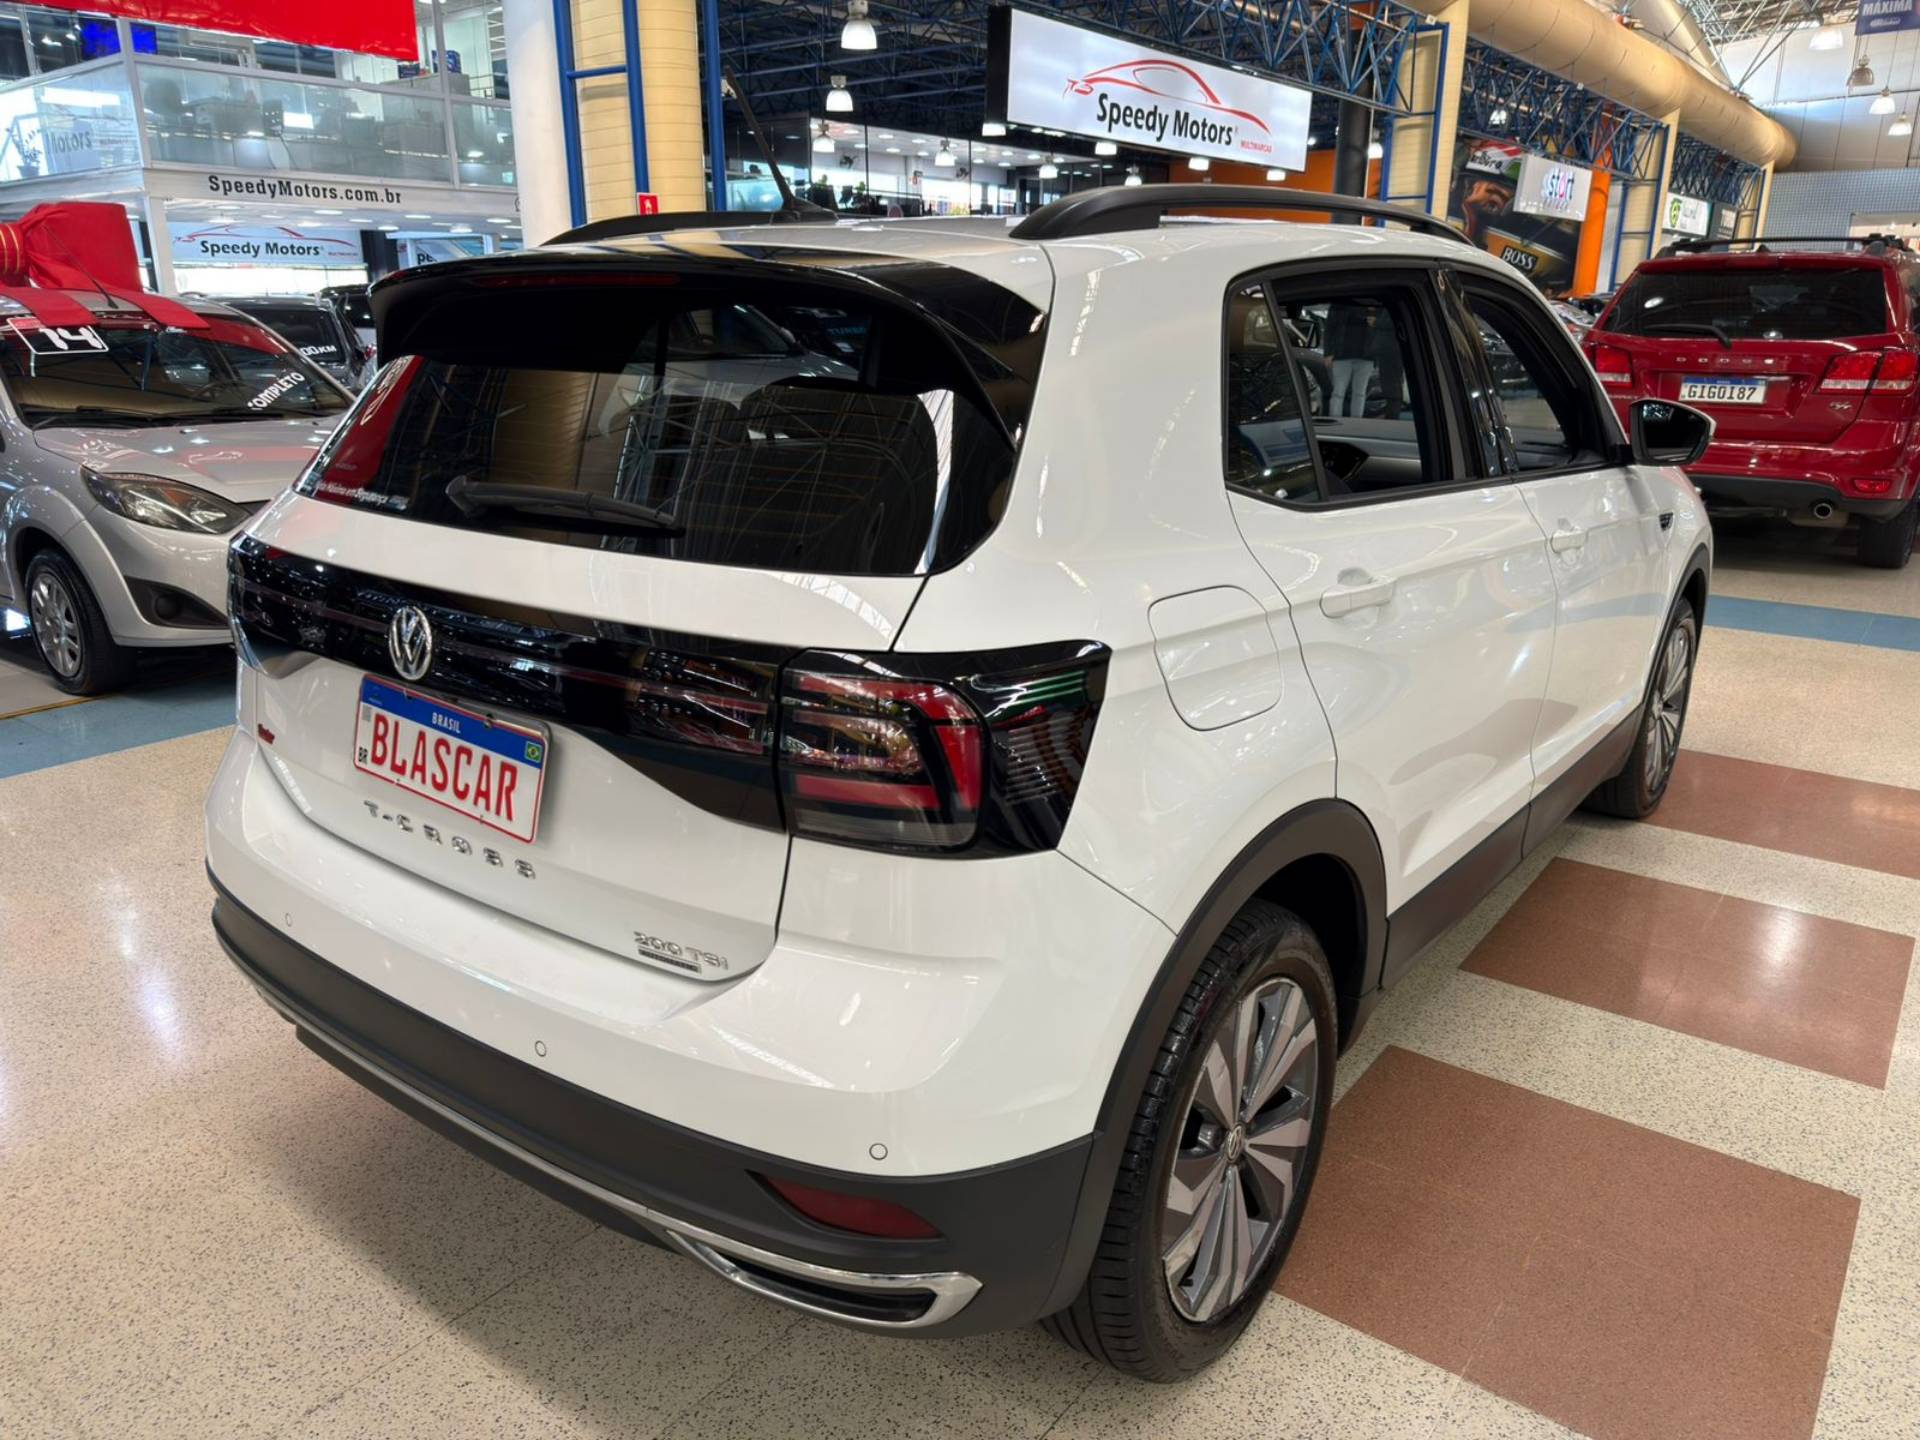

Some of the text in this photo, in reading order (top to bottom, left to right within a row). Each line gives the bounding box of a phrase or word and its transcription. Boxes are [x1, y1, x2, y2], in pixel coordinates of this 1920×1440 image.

[1096, 92, 1233, 146] Speedy Motors
[208, 174, 402, 204] SpeedyMotors.com.br
[200, 240, 261, 258] Speedy
[265, 241, 321, 256] Motors
[1502, 246, 1535, 270] BOSS
[431, 711, 462, 734] BRASIL
[370, 713, 518, 822] BLASCAR
[363, 799, 537, 880] T-CROSS
[633, 930, 682, 956] 200
